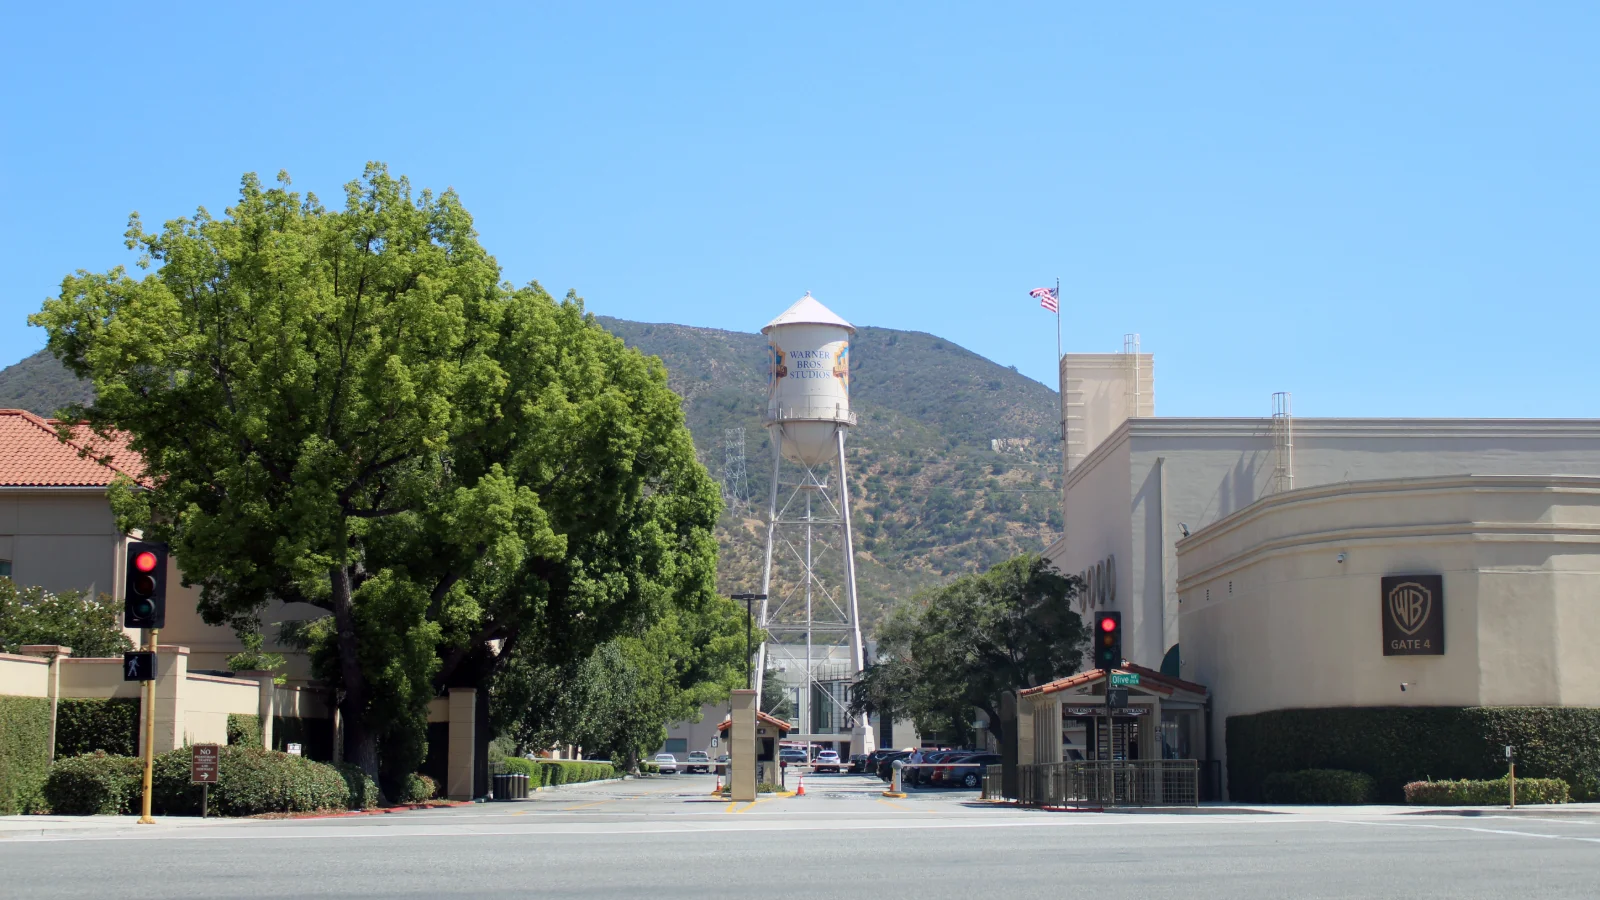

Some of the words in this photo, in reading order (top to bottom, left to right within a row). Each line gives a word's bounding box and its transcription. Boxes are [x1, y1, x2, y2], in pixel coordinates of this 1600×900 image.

[790, 351, 830, 359] WARNER
[790, 370, 830, 378] STUDIOS
[1394, 589, 1424, 626] WB
[1391, 640, 1420, 650] GATE
[1424, 638, 1430, 648] 4
